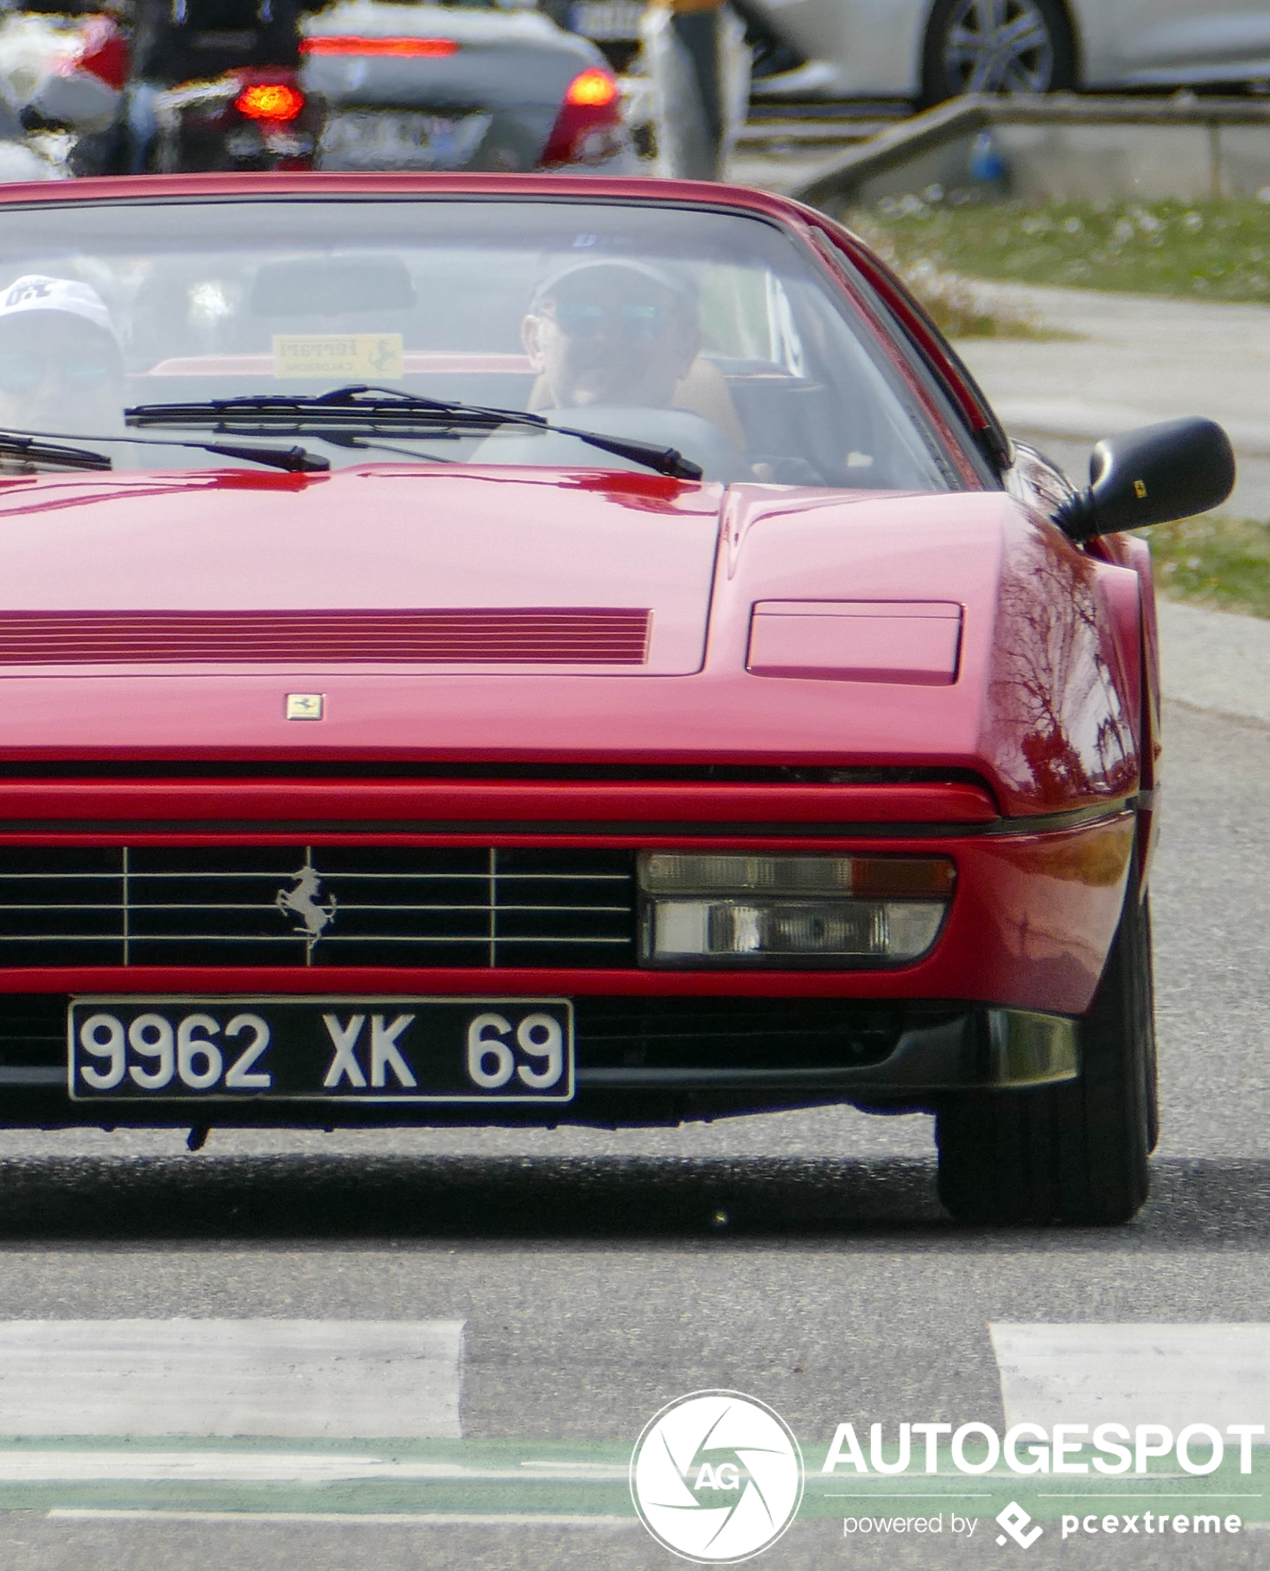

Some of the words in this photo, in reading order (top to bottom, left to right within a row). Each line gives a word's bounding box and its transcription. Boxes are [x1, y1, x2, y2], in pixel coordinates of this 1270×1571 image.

[79, 1013, 271, 1090] 9962
[322, 1014, 418, 1088] XK
[467, 1013, 564, 1089] 69
